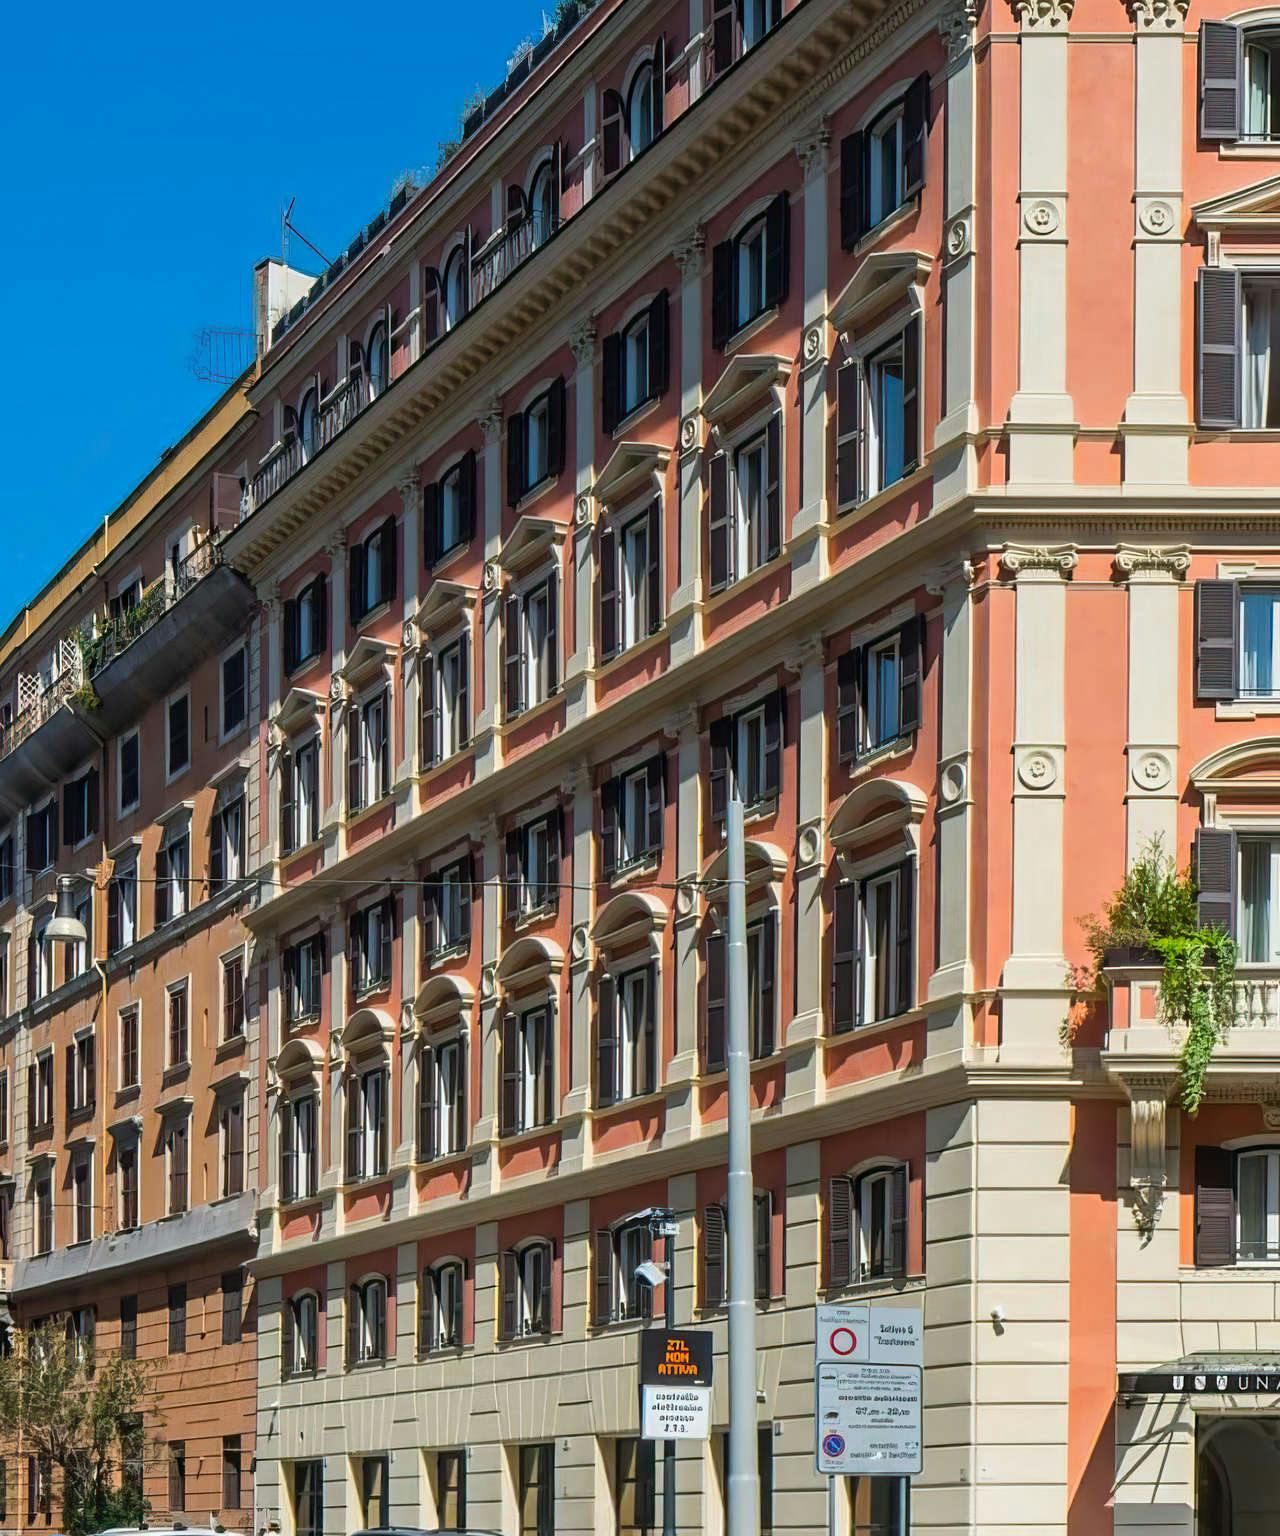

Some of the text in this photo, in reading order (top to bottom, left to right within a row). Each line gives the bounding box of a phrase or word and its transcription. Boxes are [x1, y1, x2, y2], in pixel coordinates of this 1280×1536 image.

[667, 1340, 689, 1351] ZTL
[666, 1352, 689, 1363] NON
[658, 1364, 698, 1376] ATTIVA
